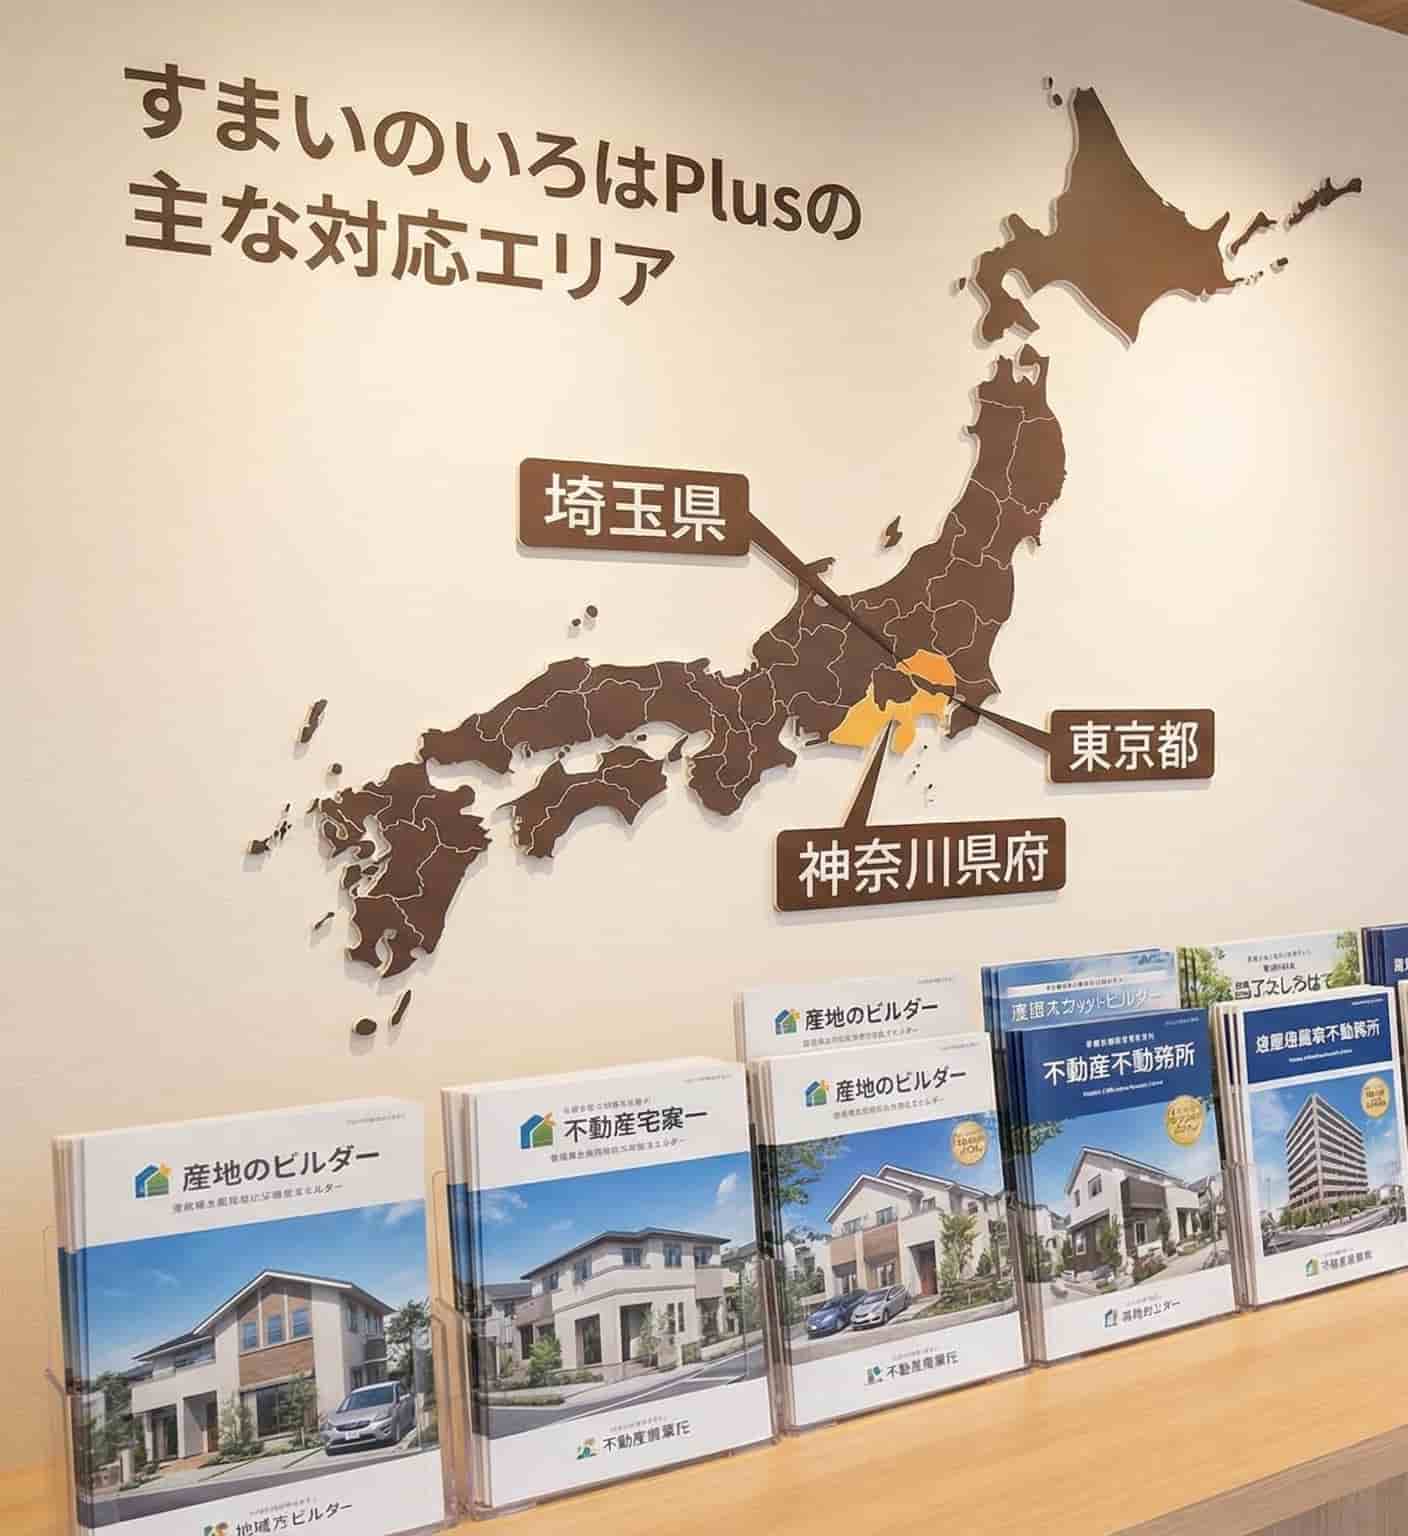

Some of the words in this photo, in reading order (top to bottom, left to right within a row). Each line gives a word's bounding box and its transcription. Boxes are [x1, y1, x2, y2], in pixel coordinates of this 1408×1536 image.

[123, 62, 864, 241] すまいのいろはPlusの
[125, 170, 677, 307] 主な対応エリア
[543, 472, 726, 542] 埼玉県
[1068, 720, 1199, 772] 東京都
[798, 831, 1049, 897] 神奈川県府
[805, 997, 938, 1031] 産地のビルダー
[836, 1066, 966, 1103] 産地のビルダー
[182, 1144, 380, 1192] 産地のビルダー
